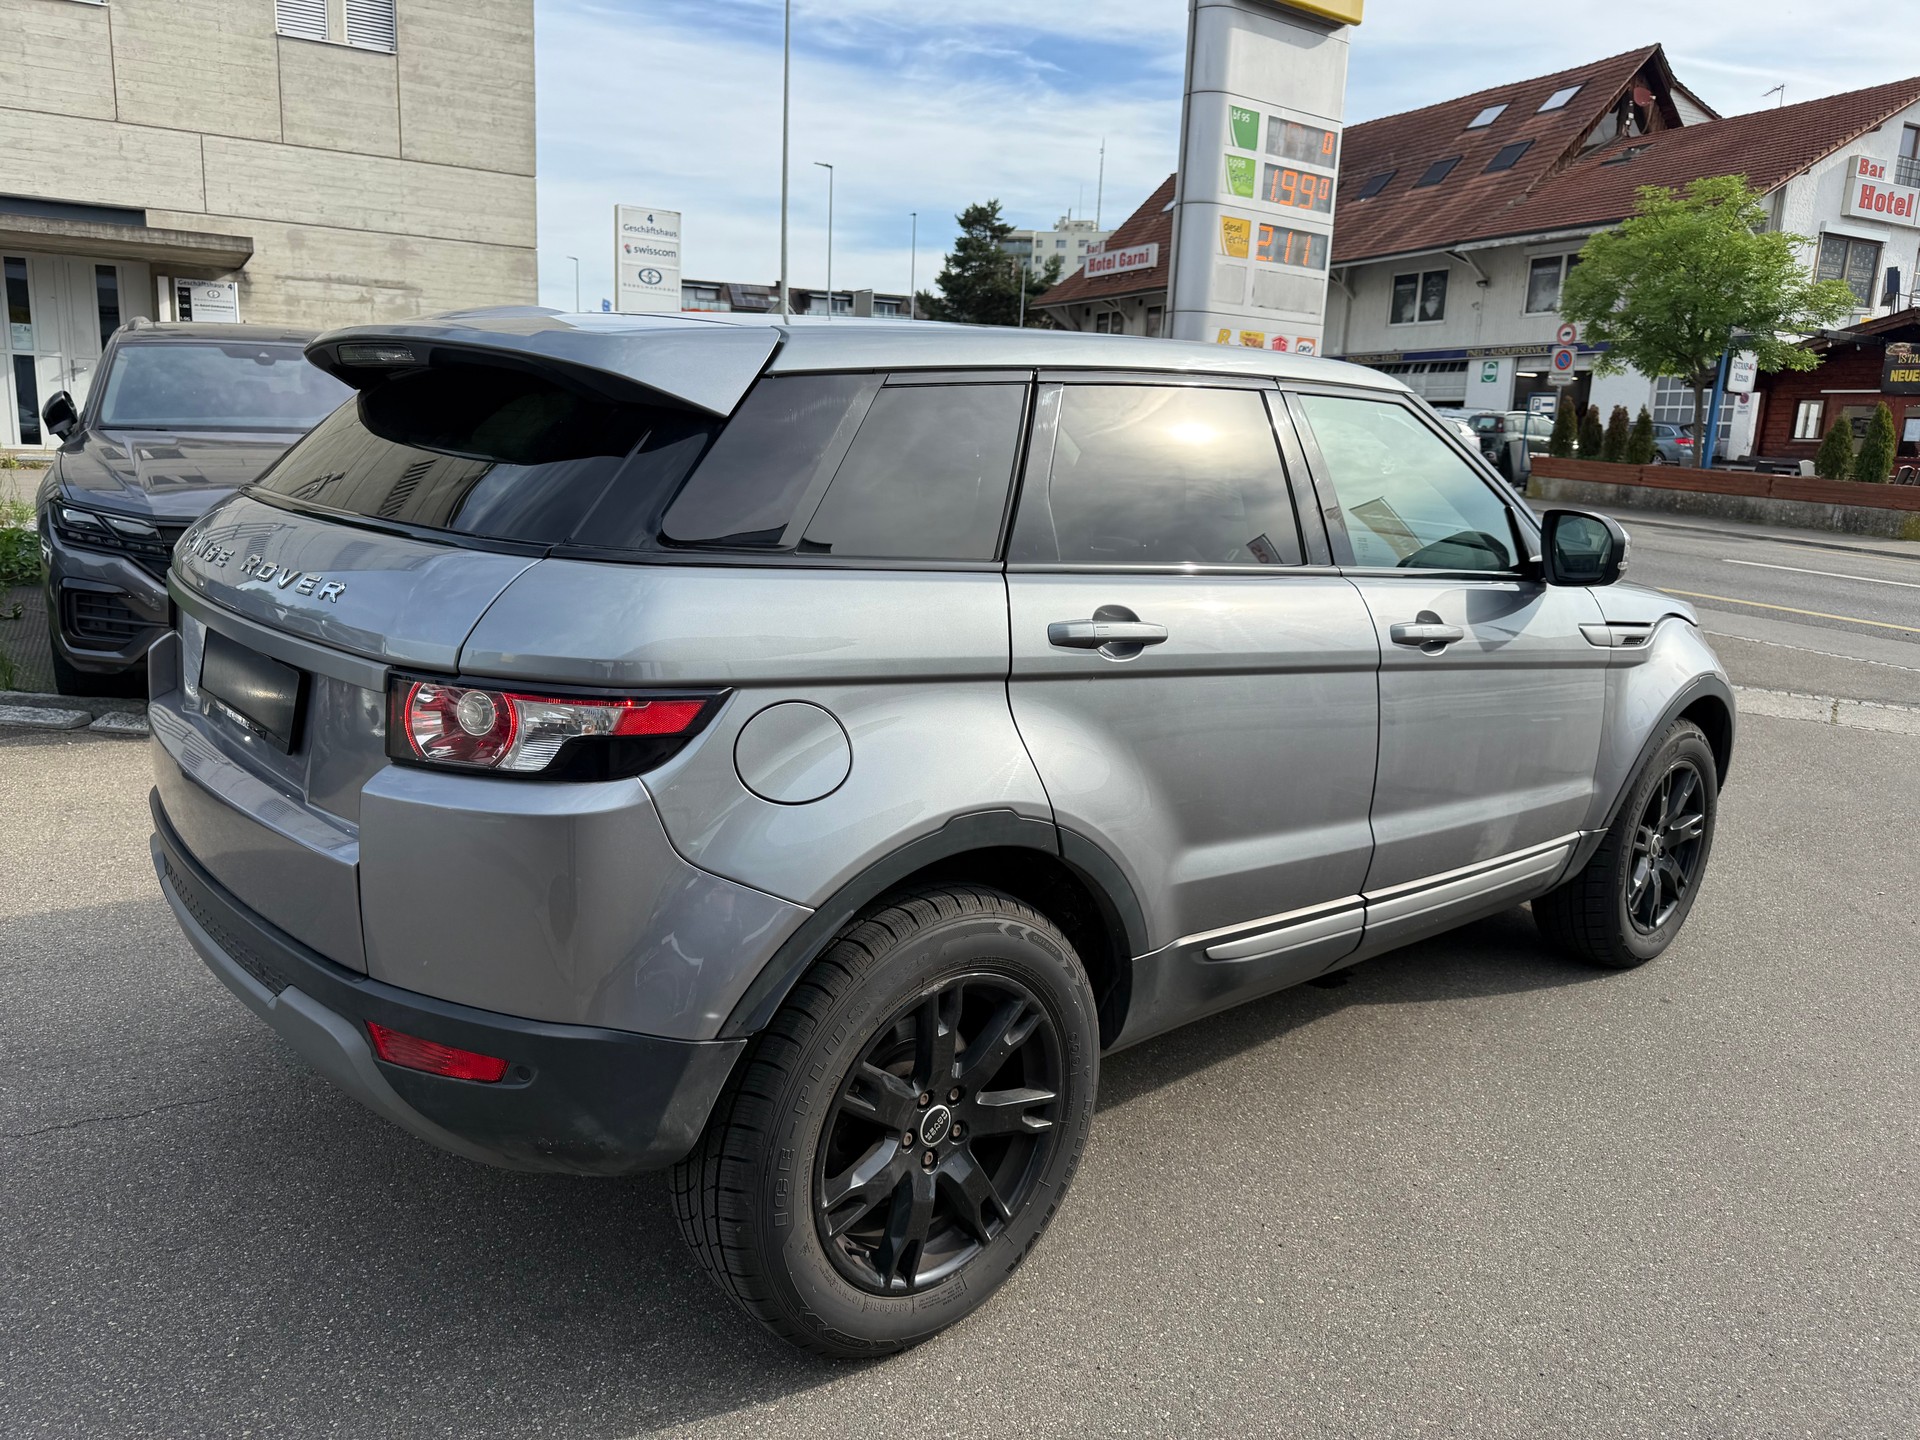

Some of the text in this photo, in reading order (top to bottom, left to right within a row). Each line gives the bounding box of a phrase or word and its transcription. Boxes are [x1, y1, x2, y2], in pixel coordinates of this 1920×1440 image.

[1858, 157, 1885, 179] Bar
[1858, 183, 1915, 218] Hotel
[647, 214, 654, 224] 4
[623, 223, 678, 238] Geschäftshaus
[633, 245, 677, 258] swisscom
[1088, 247, 1150, 273] Hotel Garni
[178, 280, 225, 288] Geschäftshaus
[1897, 353, 1920, 364] ISTA
[1890, 369, 1920, 382] NEUE
[239, 553, 347, 604] ROVER
